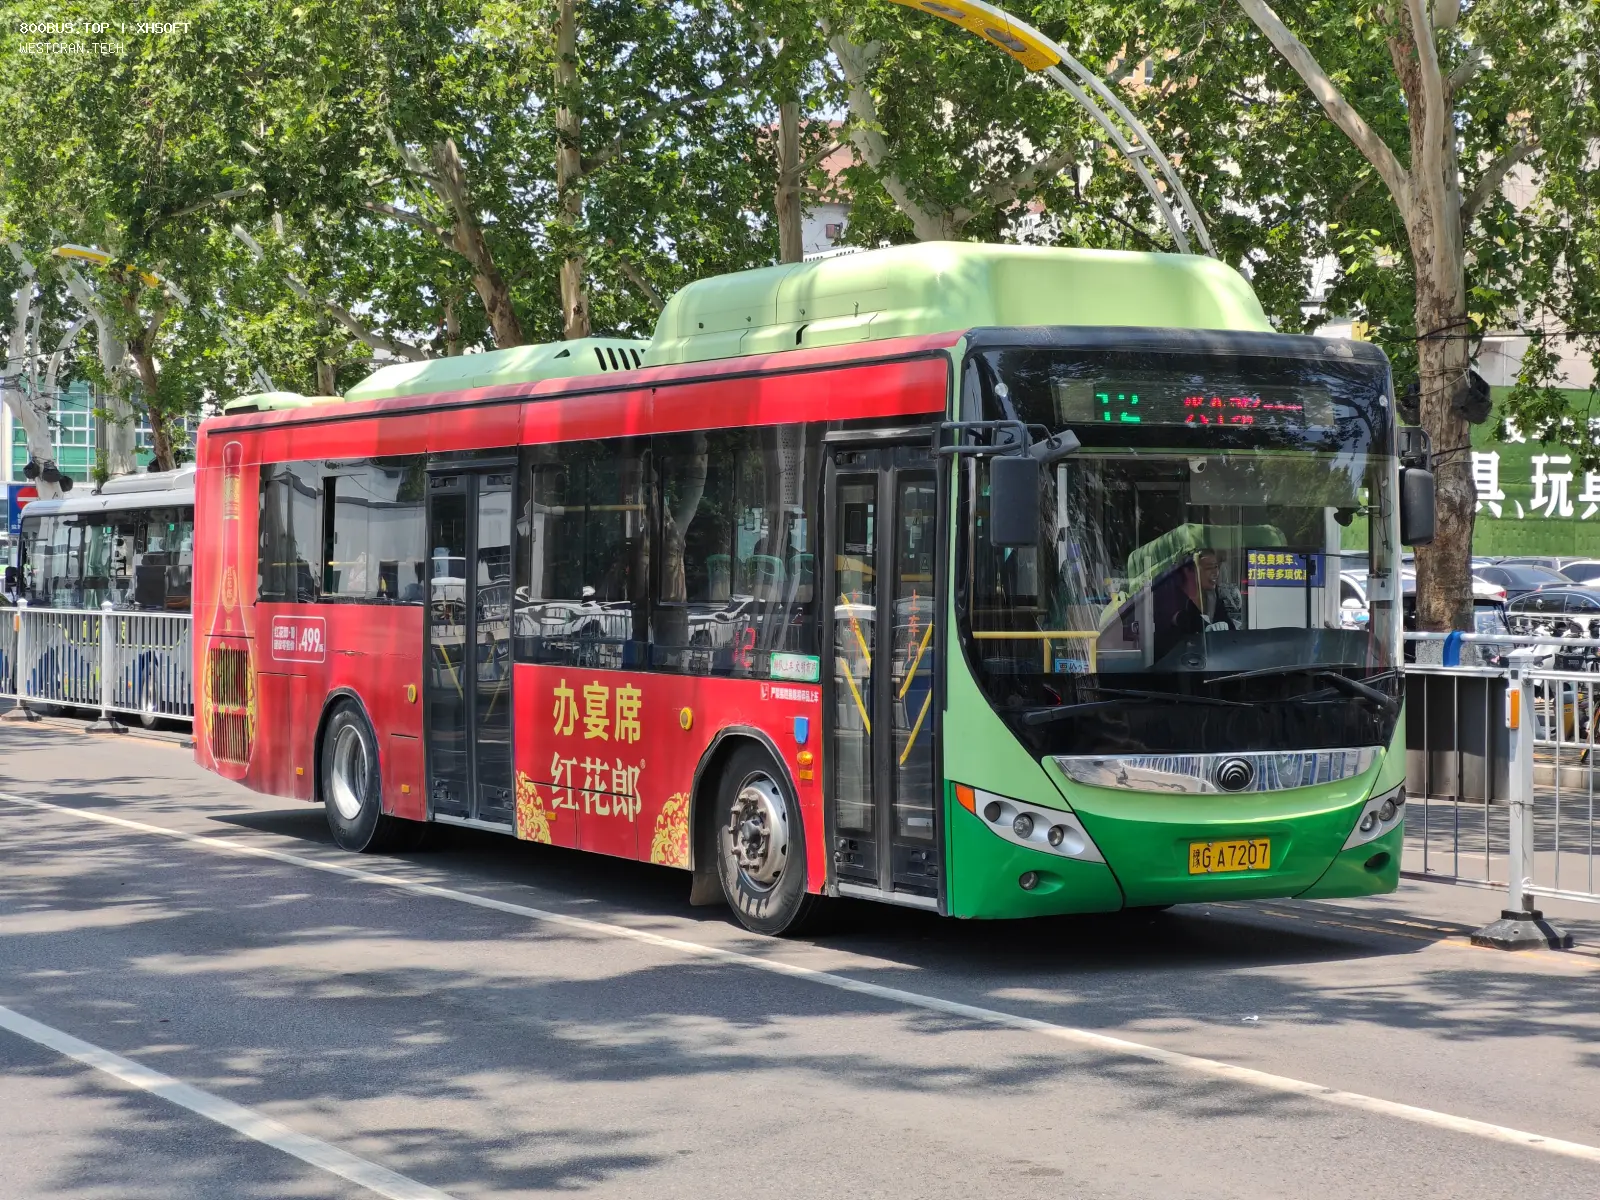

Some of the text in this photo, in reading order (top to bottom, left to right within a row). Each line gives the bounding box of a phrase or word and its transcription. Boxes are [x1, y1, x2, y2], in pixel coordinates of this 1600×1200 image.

[553, 678, 642, 744] 办宴席
[550, 751, 642, 822] 红花郎
